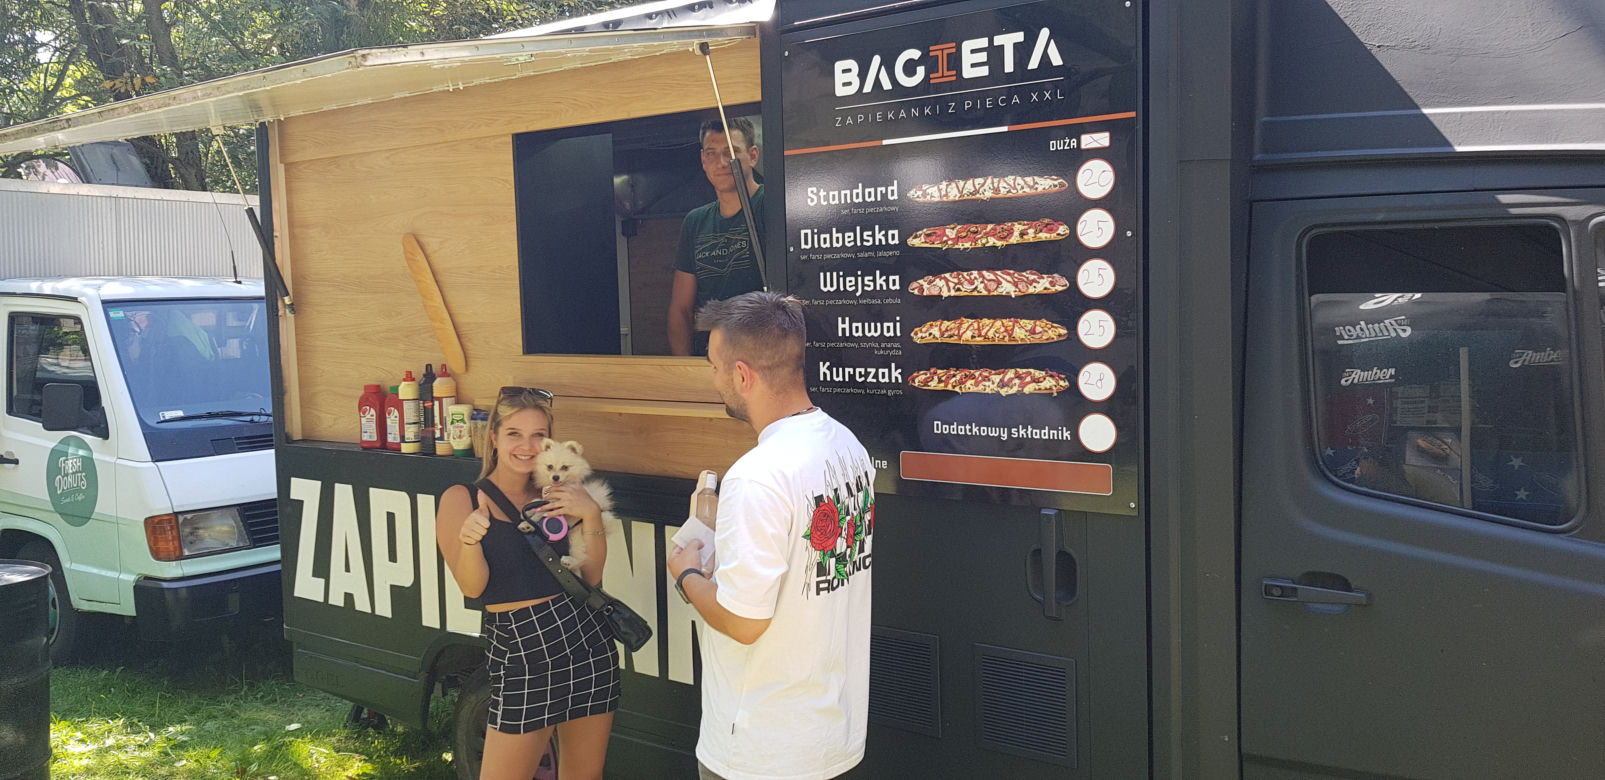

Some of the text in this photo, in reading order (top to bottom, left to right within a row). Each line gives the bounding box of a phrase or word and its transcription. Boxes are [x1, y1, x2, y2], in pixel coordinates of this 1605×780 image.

[834, 27, 1064, 97] BAGIETA
[835, 88, 1065, 127] ZAPIEKANKI Z PIECA XXL
[1049, 136, 1077, 151] DUŻA
[807, 180, 899, 207] Standard
[800, 225, 900, 250] Diabelska
[1080, 219, 1110, 239] 25
[711, 248, 728, 256] AND
[820, 270, 900, 297] Wiejska
[1082, 267, 1108, 287] 25
[837, 316, 901, 338] Hawai
[1082, 319, 1109, 337] 25
[1509, 348, 1563, 367] Ambe
[819, 361, 902, 383] Kurczak
[1082, 370, 1105, 390] 28
[887, 388, 903, 396] gyros
[933, 420, 1071, 440] Dodatkowy składnik
[58, 456, 82, 476] FRESH
[55, 473, 87, 494] DONUTS
